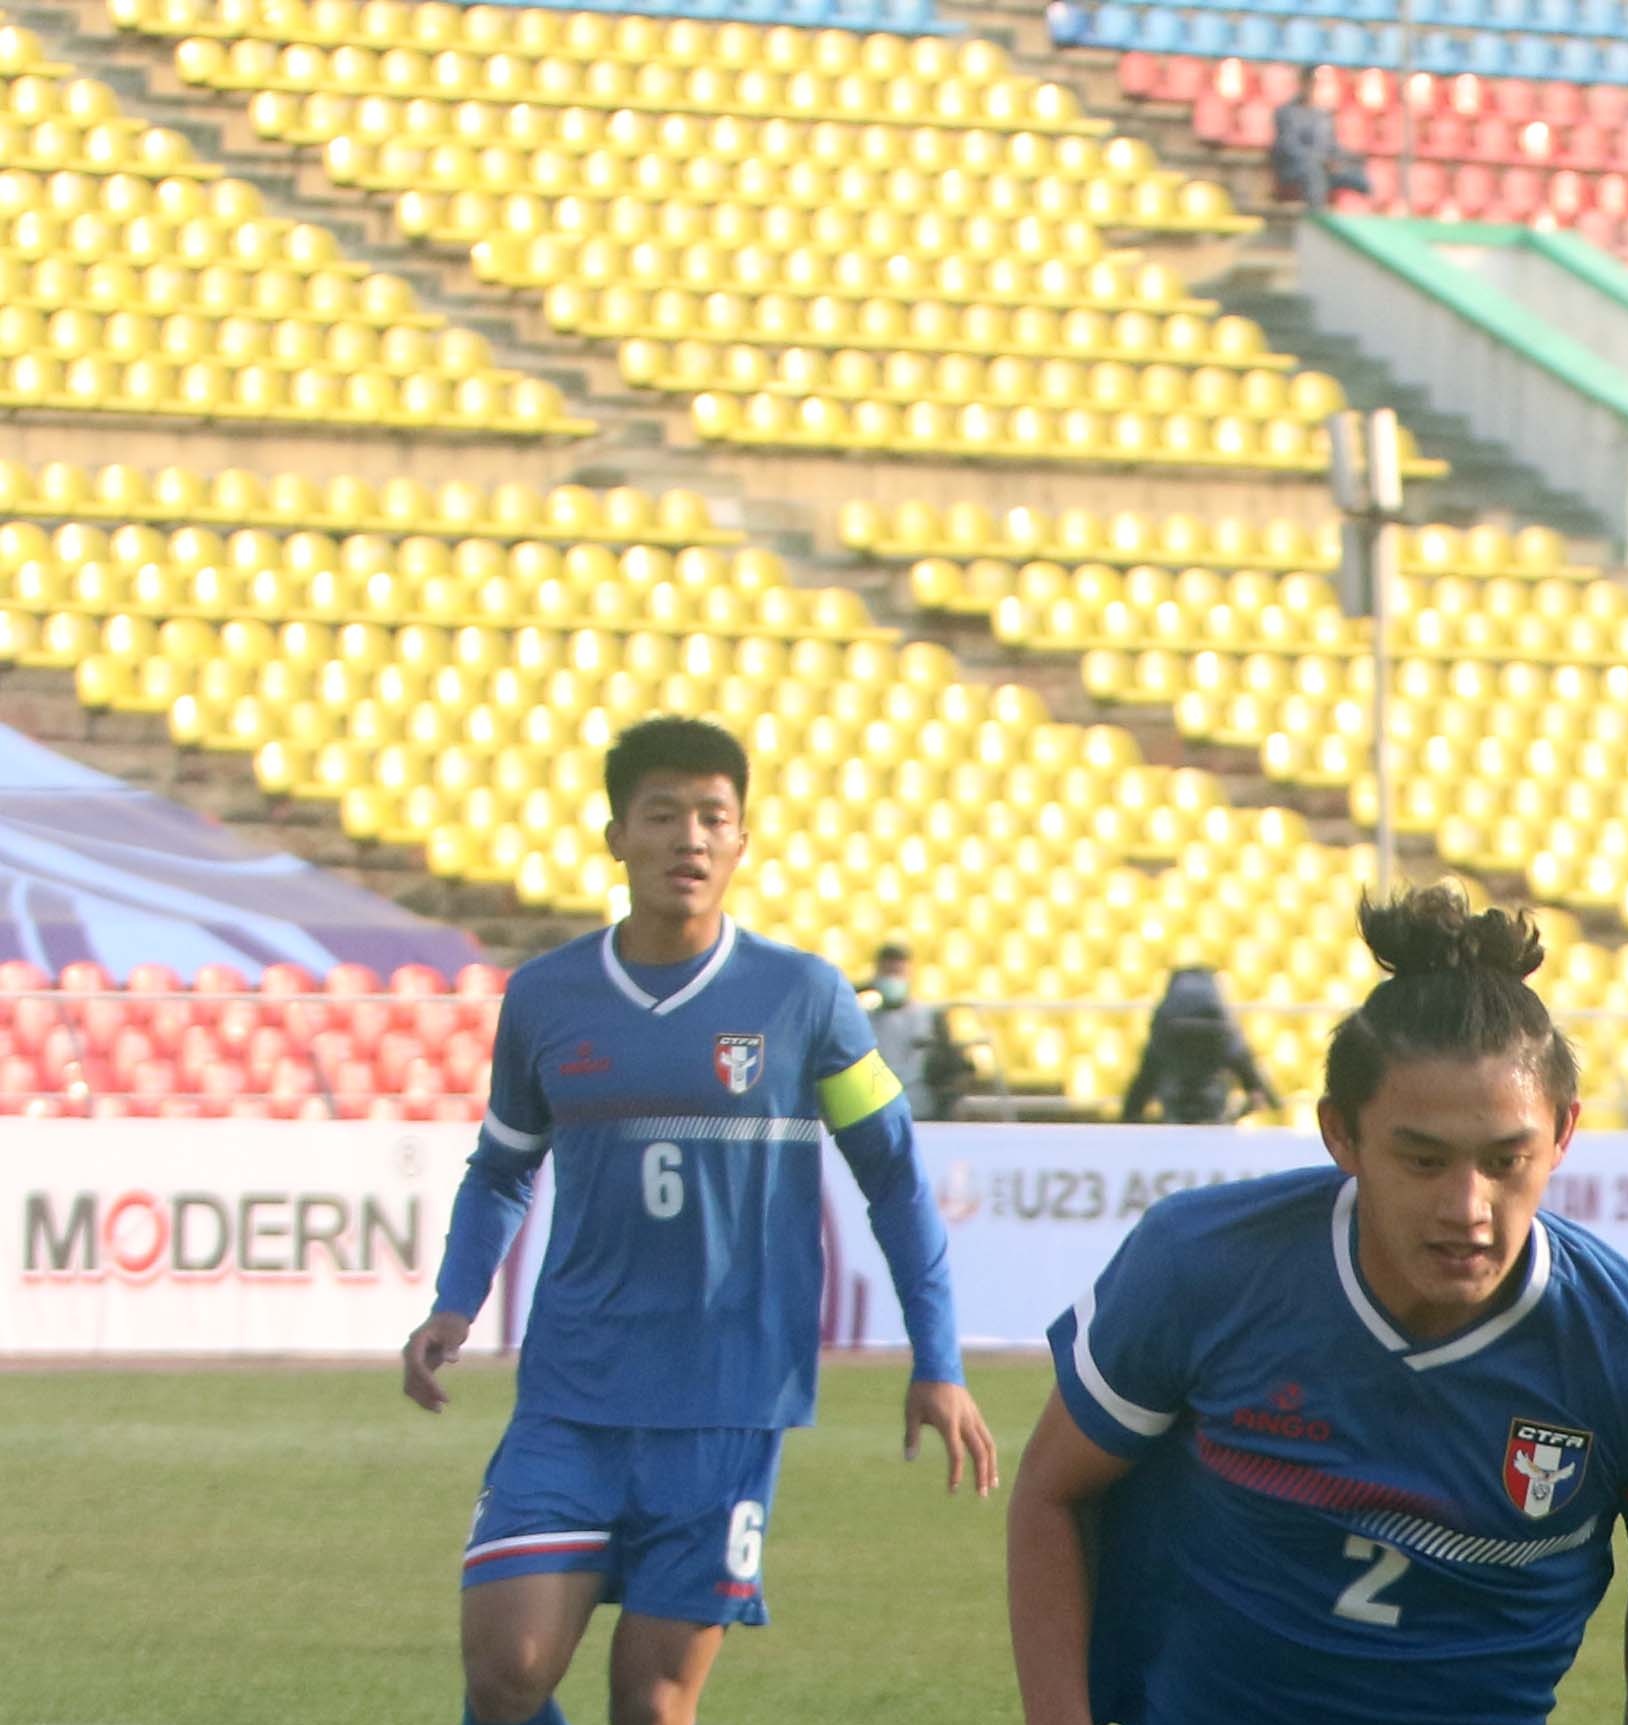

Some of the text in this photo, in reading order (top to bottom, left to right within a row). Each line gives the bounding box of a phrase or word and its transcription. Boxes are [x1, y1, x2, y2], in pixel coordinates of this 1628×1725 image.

[642, 1141, 684, 1219] 6
[23, 1187, 422, 1273] MODERN
[1517, 1426, 1584, 1448] CTFA
[726, 1500, 764, 1579] 6
[1333, 1534, 1411, 1627] 2
